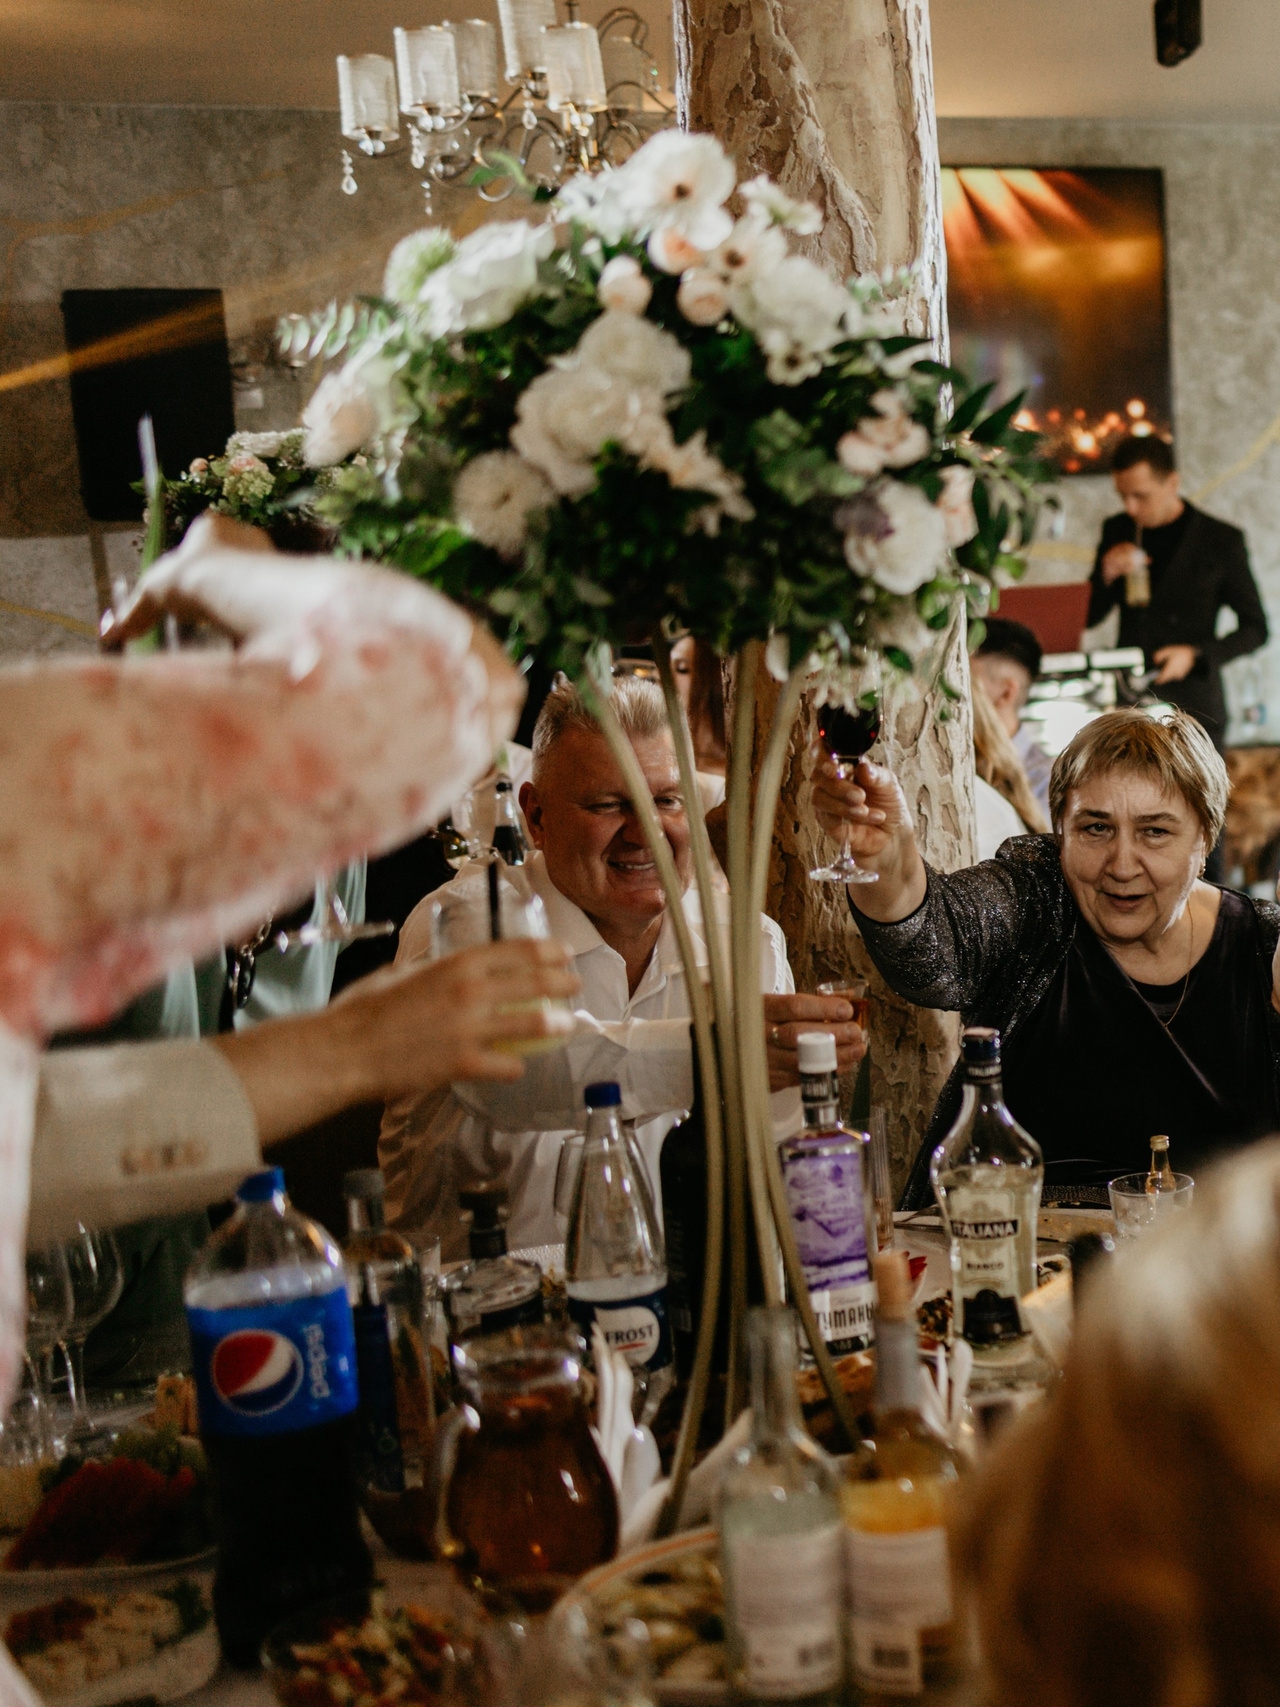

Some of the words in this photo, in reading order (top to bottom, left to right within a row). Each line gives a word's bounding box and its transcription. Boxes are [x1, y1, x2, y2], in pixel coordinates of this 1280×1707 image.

[953, 1220, 1014, 1237] ITALIANA
[604, 1324, 655, 1343] FROST
[303, 1323, 330, 1398] pepsi
